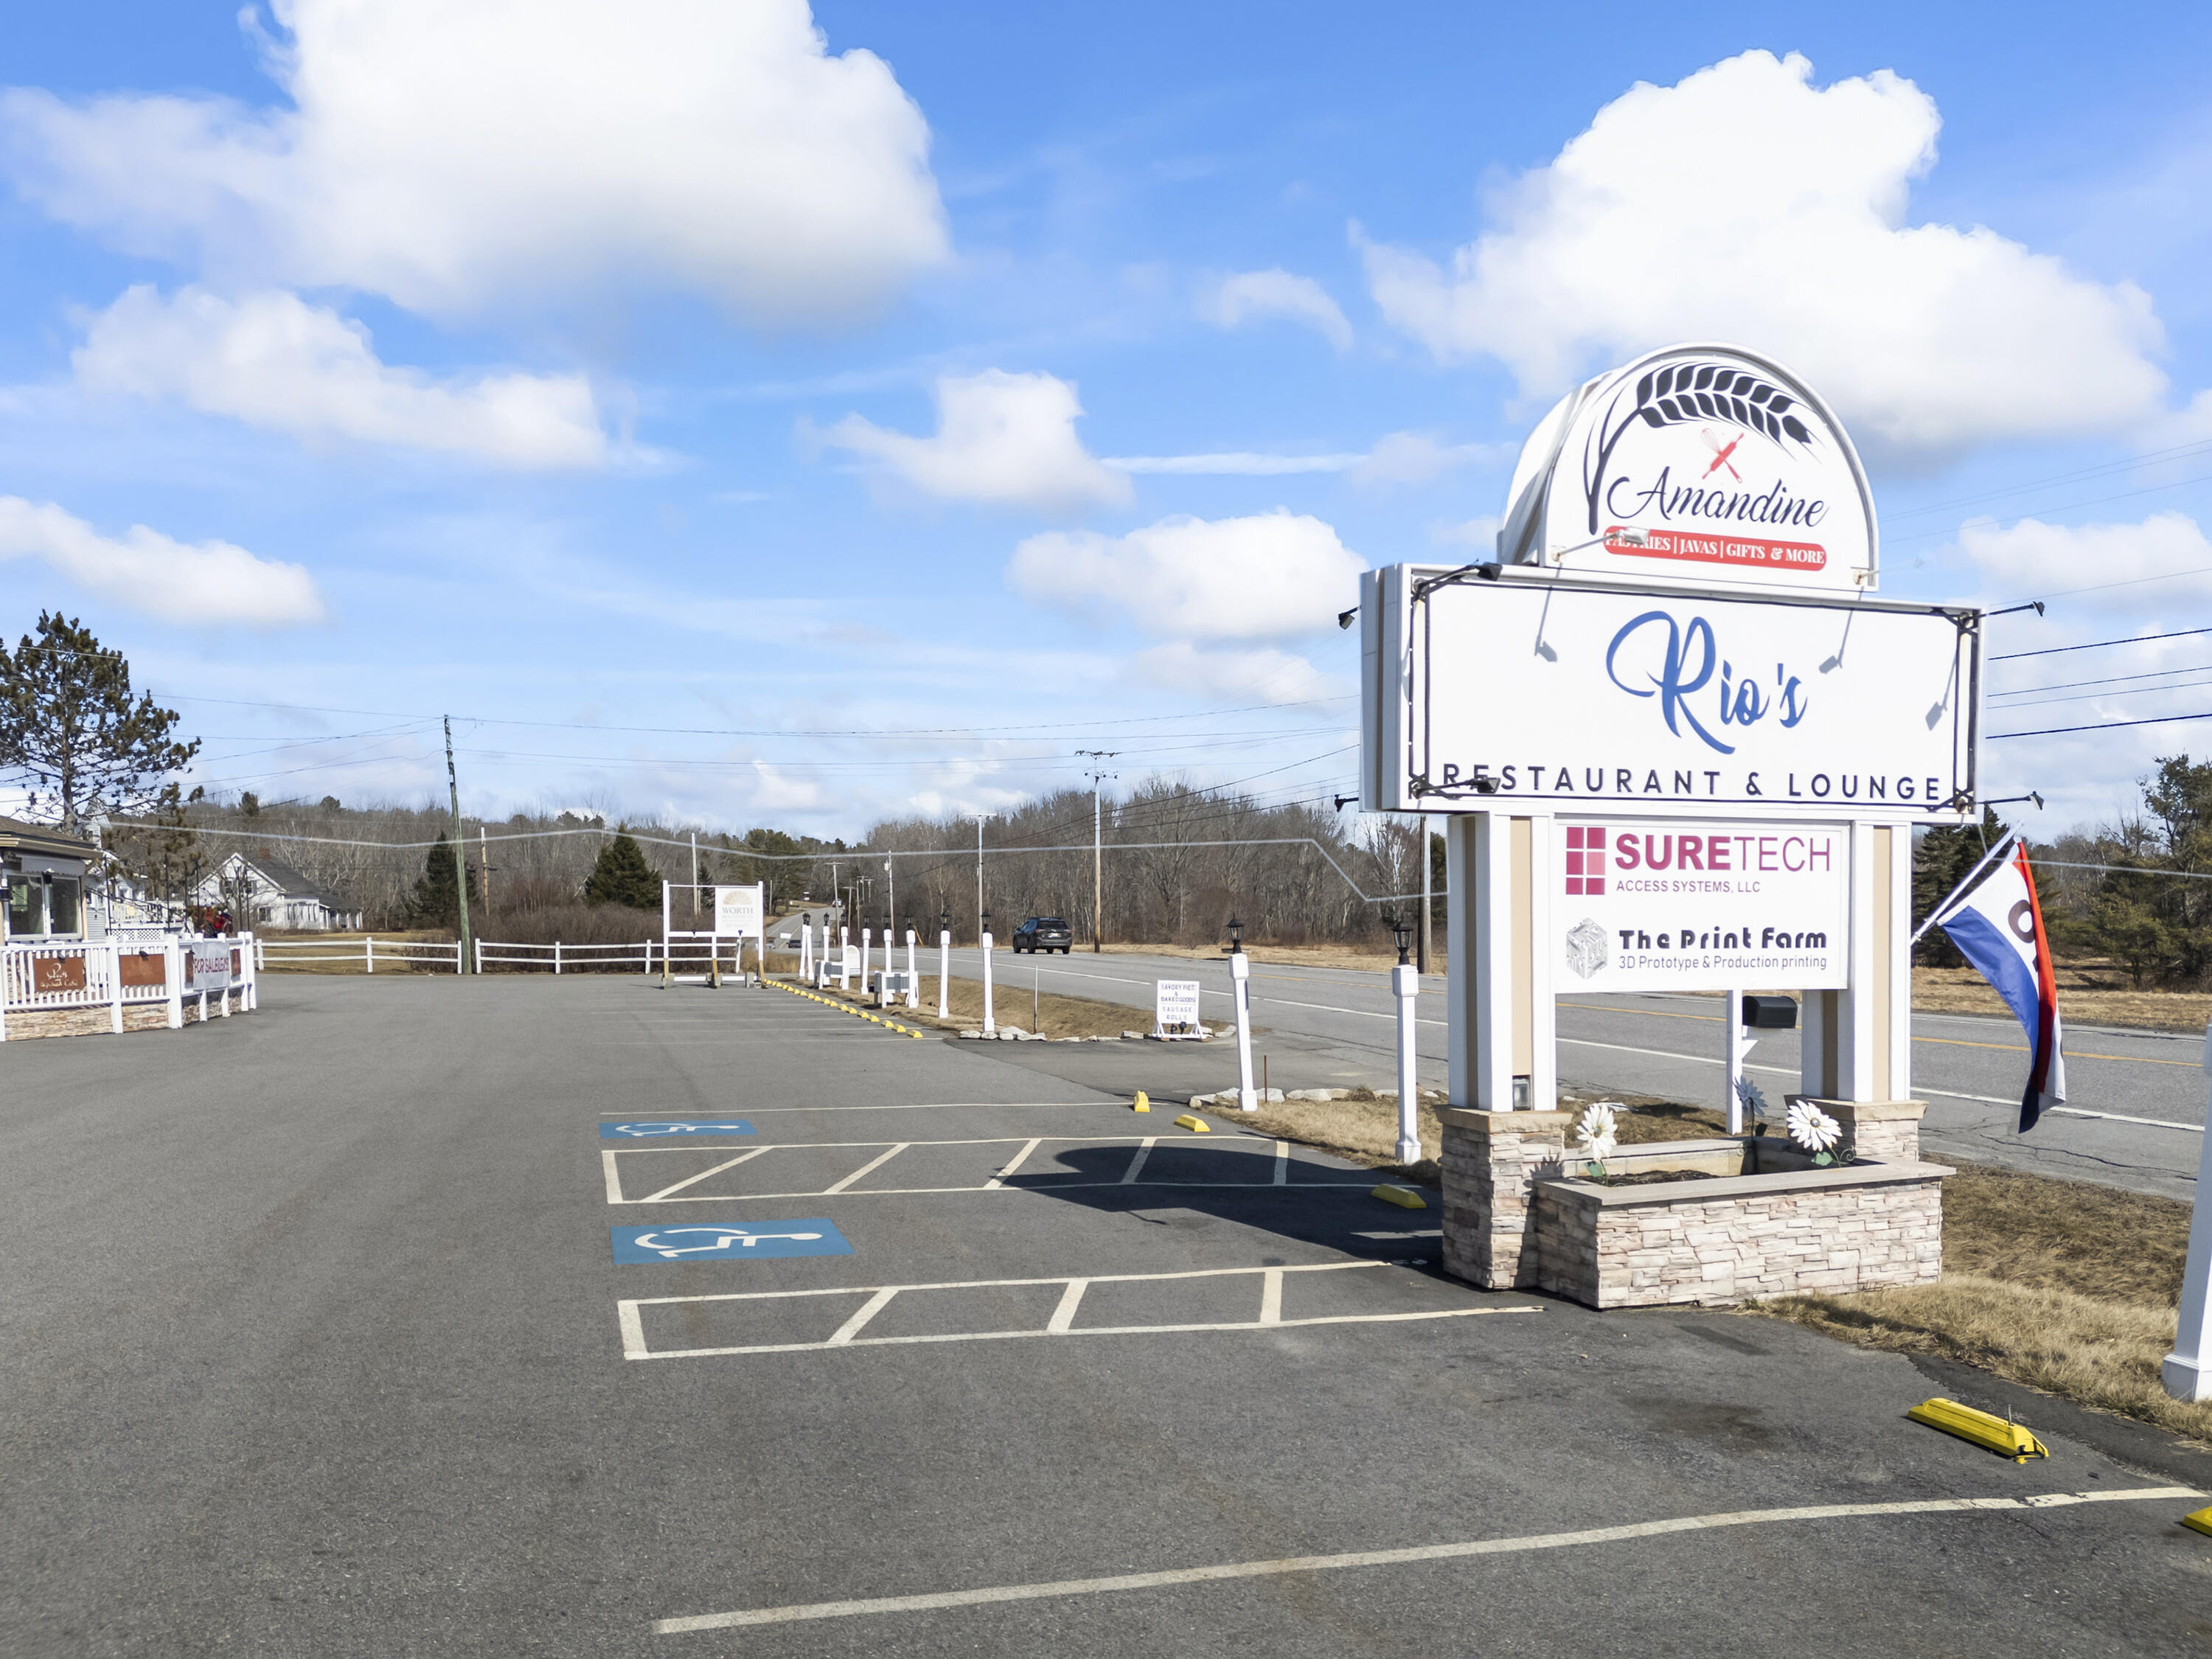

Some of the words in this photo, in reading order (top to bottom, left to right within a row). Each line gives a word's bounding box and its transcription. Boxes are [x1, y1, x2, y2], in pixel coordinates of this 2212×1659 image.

[1607, 466, 1829, 527] Amandine
[1680, 539, 1717, 555] JAVAS
[1726, 543, 1765, 560] GIFTS
[1770, 547, 1783, 561] &
[1785, 549, 1825, 564] MORE
[1606, 610, 1808, 754] Rio's
[1745, 771, 1763, 796] &
[1788, 773, 1939, 801] LOUNGE
[1615, 832, 1830, 872] SURETECH
[1616, 880, 1668, 892] ACCESS
[1672, 880, 1733, 894] SYSTEMS,
[1738, 881, 1761, 893] LLC
[1618, 930, 1670, 950] The
[1680, 925, 1752, 950] Print
[1761, 927, 1827, 949] Farm
[1618, 956, 1635, 969] 3D
[1639, 956, 1700, 972] Prototype
[1702, 956, 1711, 968] &
[1714, 956, 1779, 969] Production
[1781, 956, 1827, 971] printing
